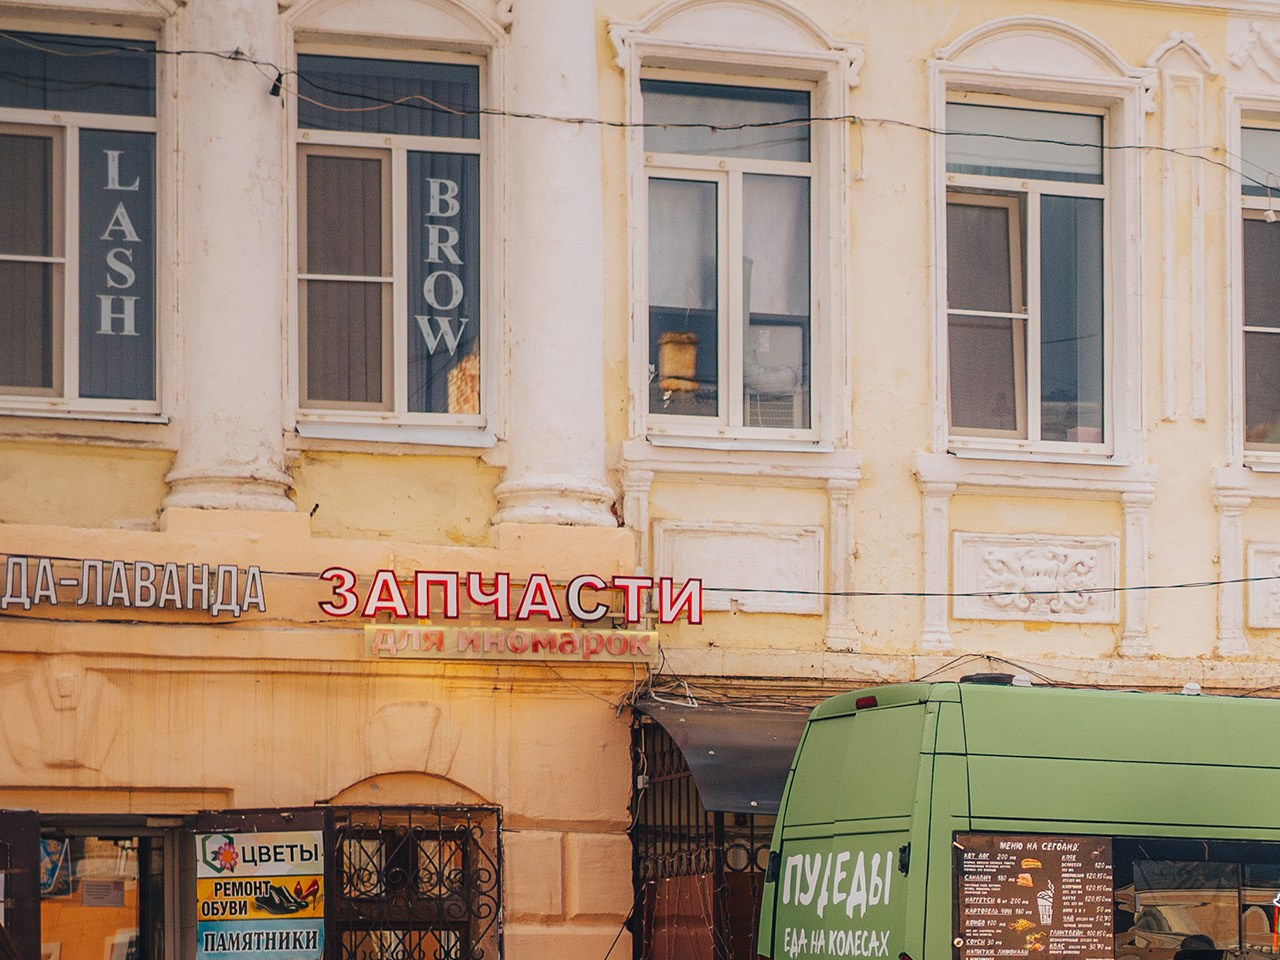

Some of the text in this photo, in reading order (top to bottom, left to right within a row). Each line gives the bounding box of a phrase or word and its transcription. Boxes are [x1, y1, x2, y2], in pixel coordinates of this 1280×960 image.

[95, 149, 141, 336] LASH
[414, 178, 469, 357] BROW
[0, 556, 267, 618] ДА-ЛАВАНДА
[318, 566, 703, 626] ЗАПЧАСТИ
[371, 628, 651, 661] для иномарок
[242, 843, 318, 866] ЦВЕТЫ
[1000, 841, 1023, 851] МЕНЮ
[1027, 842, 1038, 851] НА
[214, 880, 271, 897] РЕМОНТ
[201, 900, 248, 916] ОБУВИ
[204, 930, 318, 952] ПАМЯТНИКИ
[784, 927, 890, 959] ЕДА НА КОЛЕСАХ
